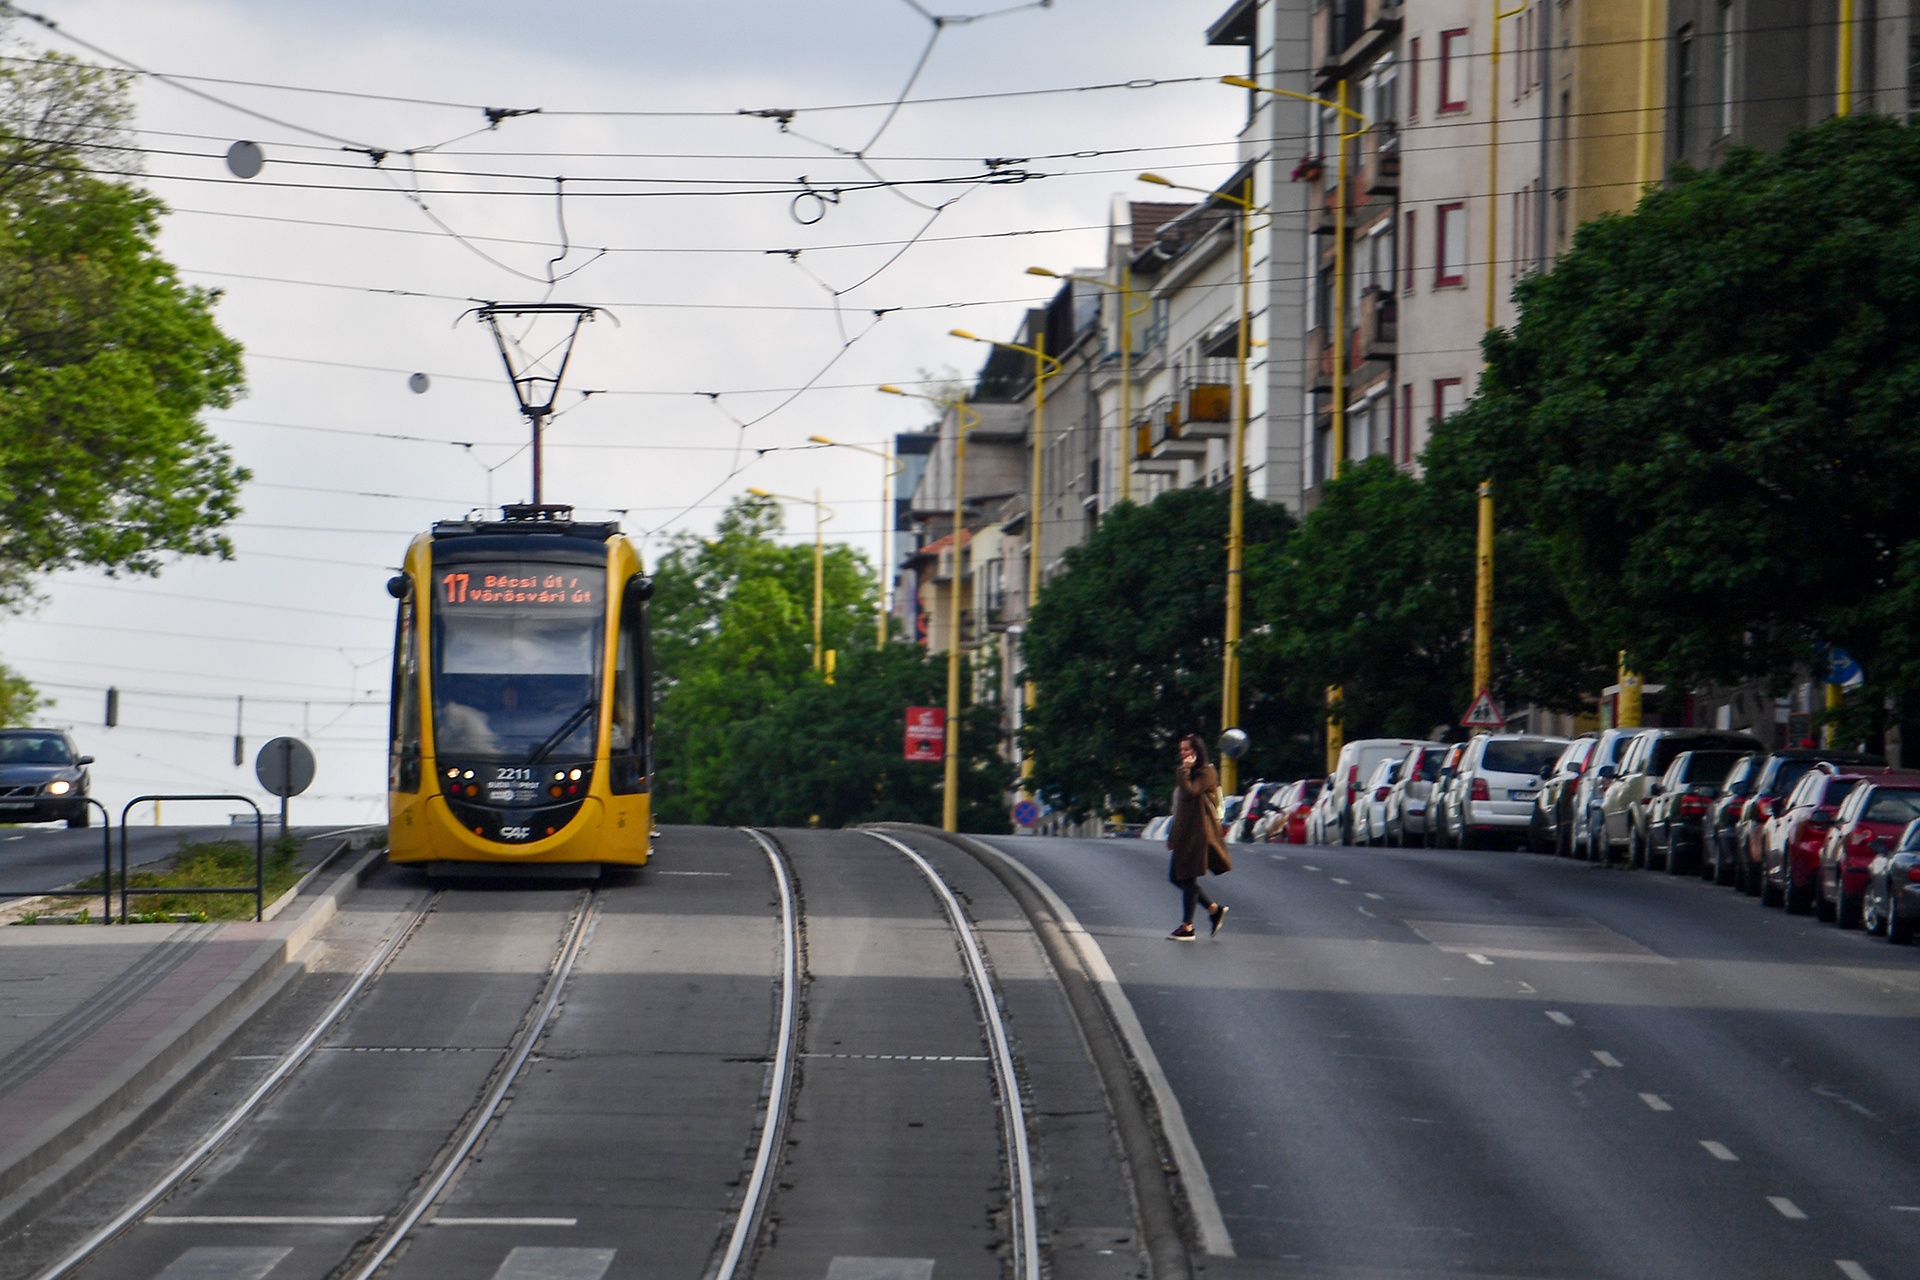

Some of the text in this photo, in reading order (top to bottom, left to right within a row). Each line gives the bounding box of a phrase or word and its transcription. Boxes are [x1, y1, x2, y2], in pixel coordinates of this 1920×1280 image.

[443, 573, 470, 602] 17
[485, 575, 537, 588] Bécsi
[543, 575, 563, 588] út
[572, 590, 591, 603] út
[497, 768, 530, 780] 2211
